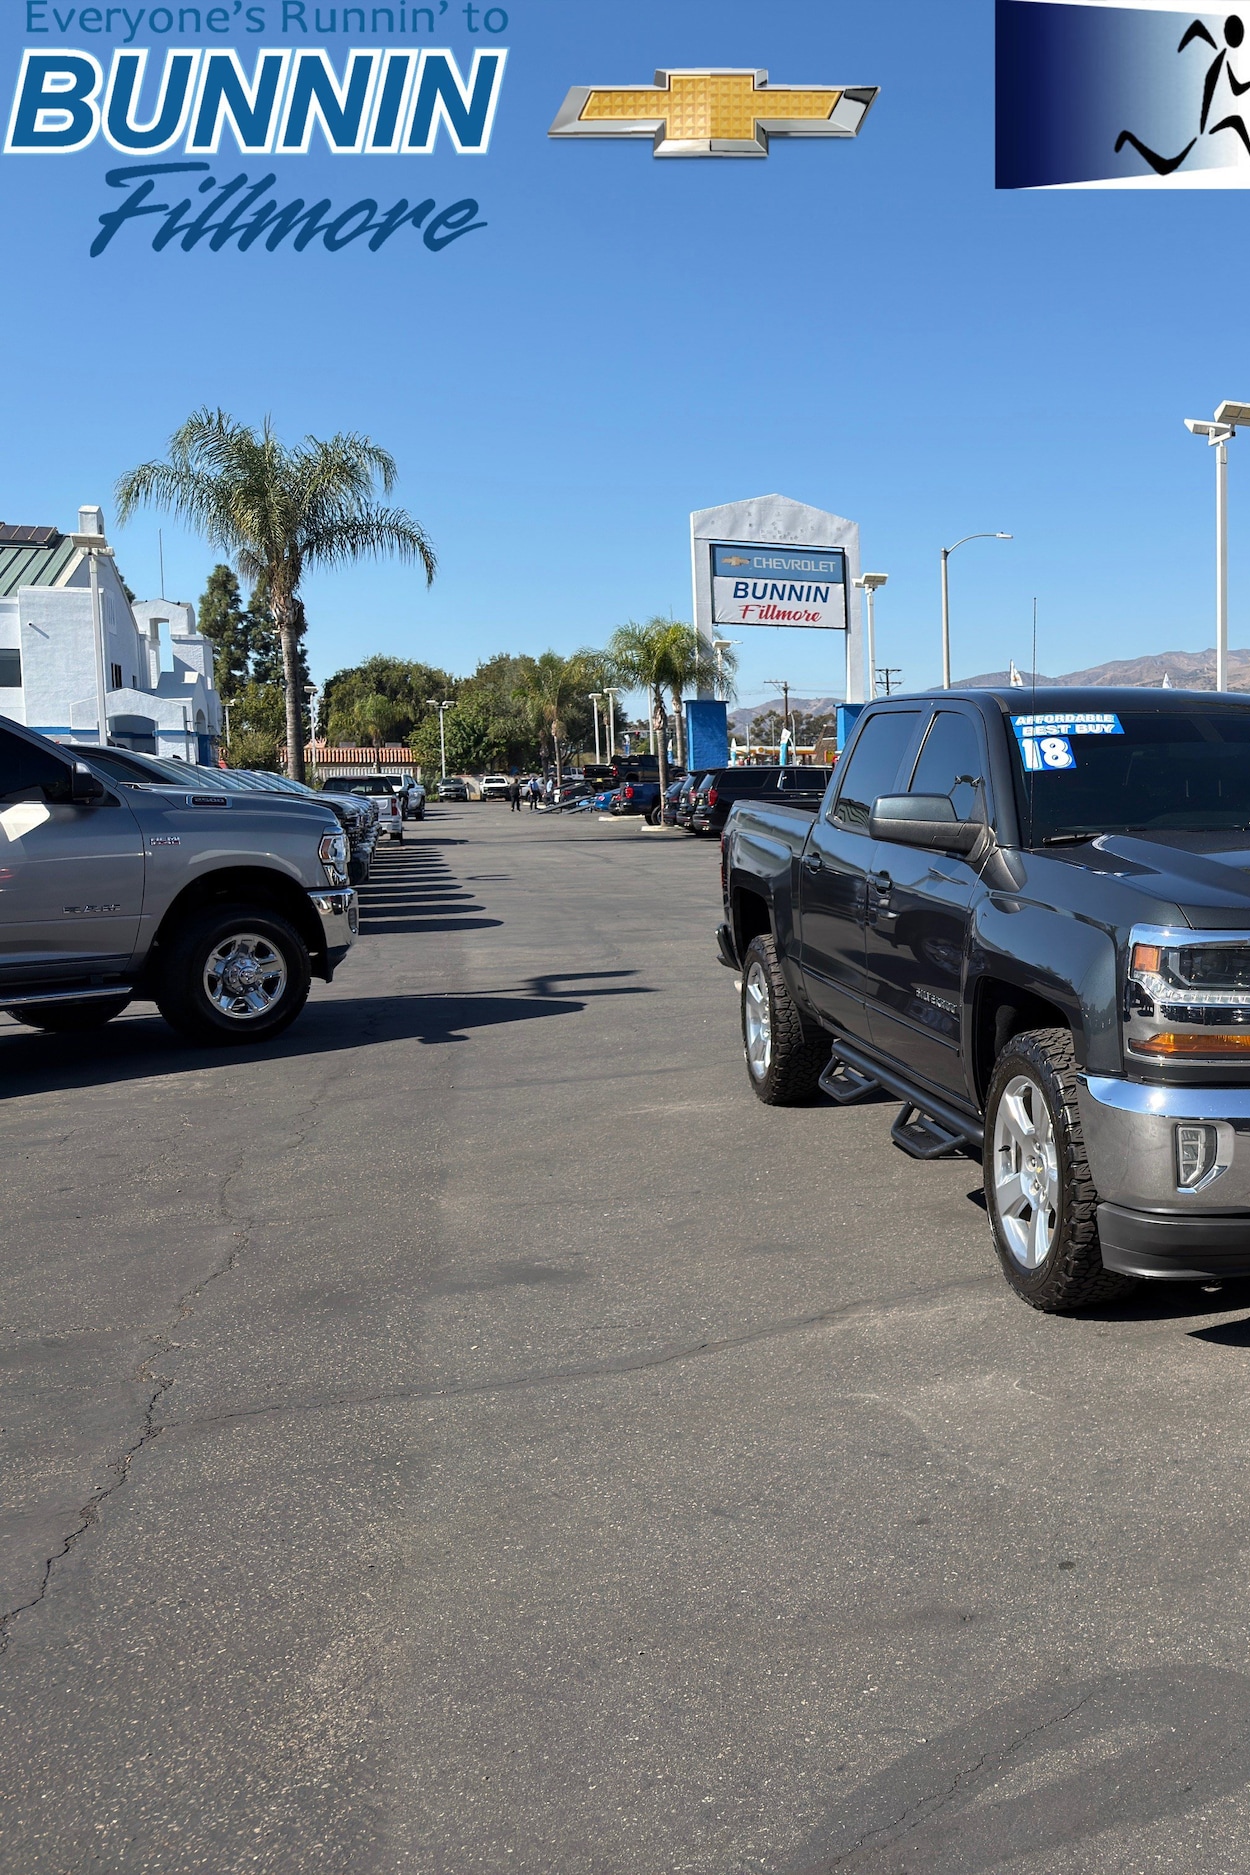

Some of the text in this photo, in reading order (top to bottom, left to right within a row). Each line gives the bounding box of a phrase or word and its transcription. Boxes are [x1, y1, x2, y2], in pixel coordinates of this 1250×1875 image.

[753, 556, 836, 573] CHEVROLET
[733, 581, 830, 603] BUNNIN
[738, 604, 822, 622] Fillmore
[1014, 714, 1115, 726] AFFORDABLE
[1022, 724, 1115, 737] BEST BUY
[1022, 737, 1073, 769] 18
